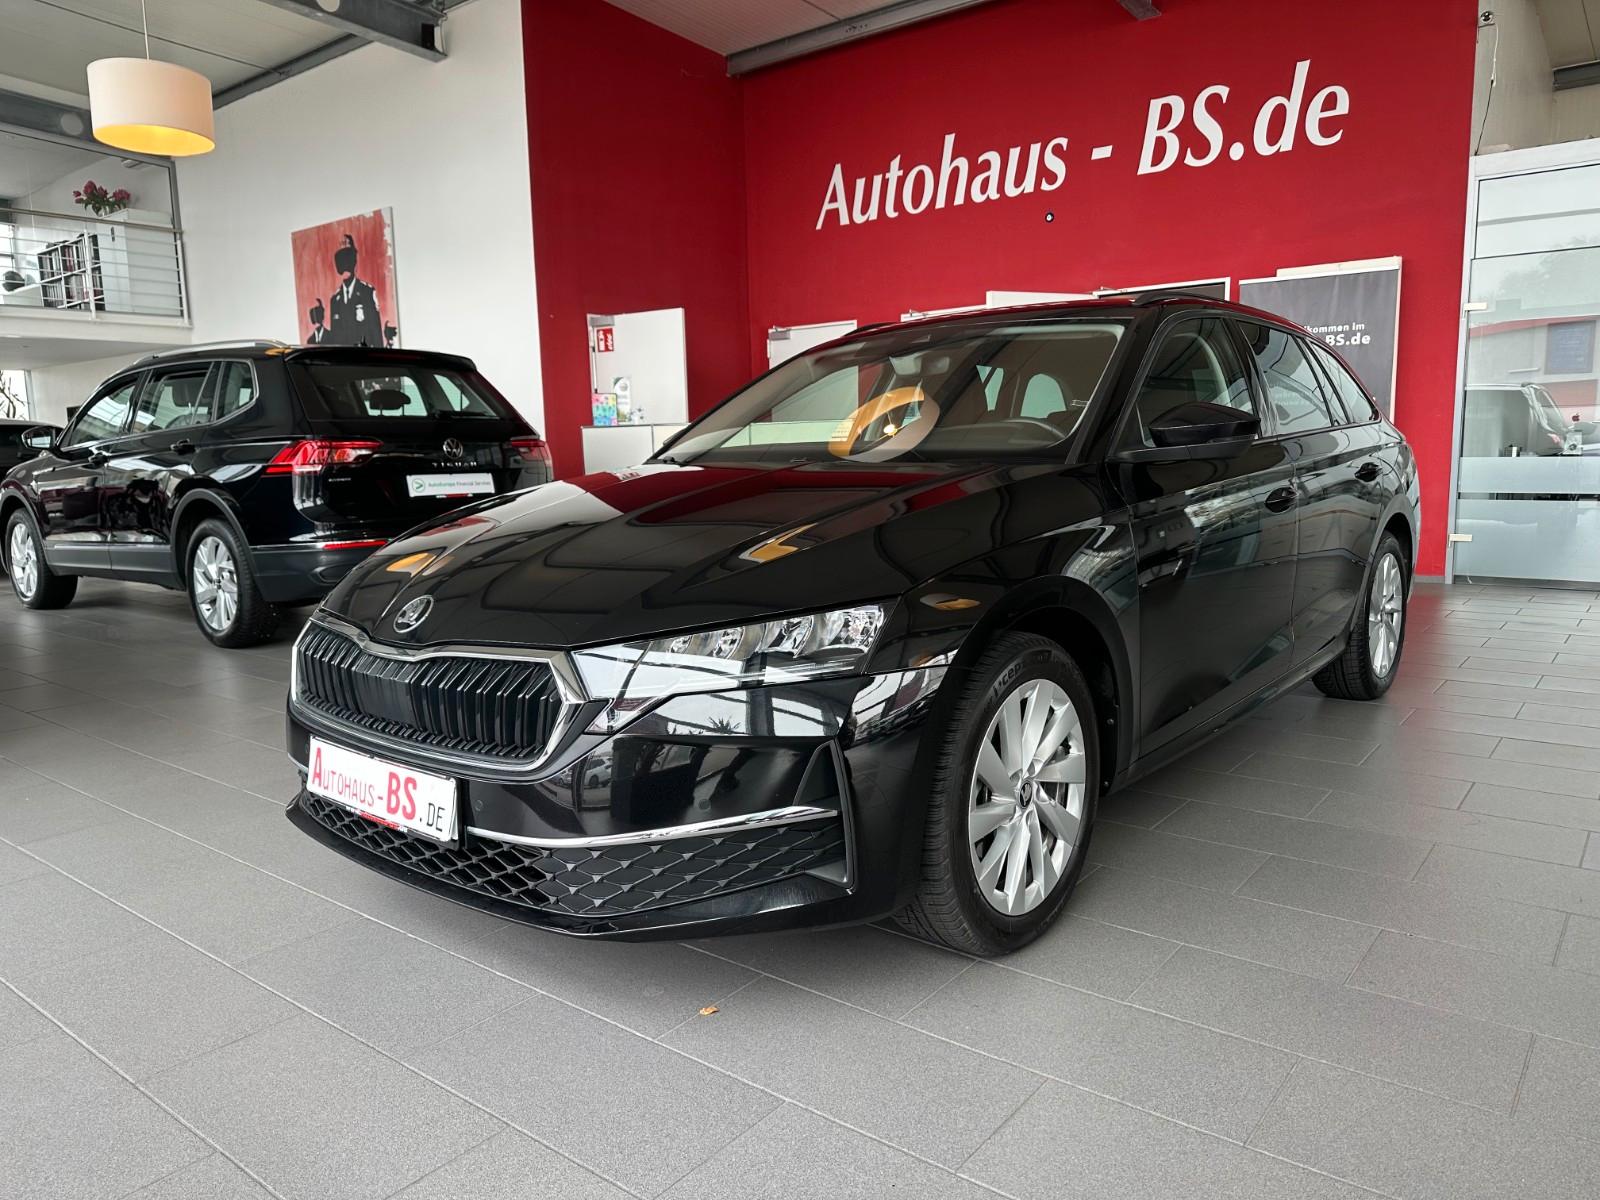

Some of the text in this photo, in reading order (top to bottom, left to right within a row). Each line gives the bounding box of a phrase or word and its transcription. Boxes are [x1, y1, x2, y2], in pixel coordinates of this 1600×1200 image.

[816, 132, 1068, 230] Autohaus
[1137, 59, 1350, 175] BS.de
[1325, 333, 1371, 346] BS.de
